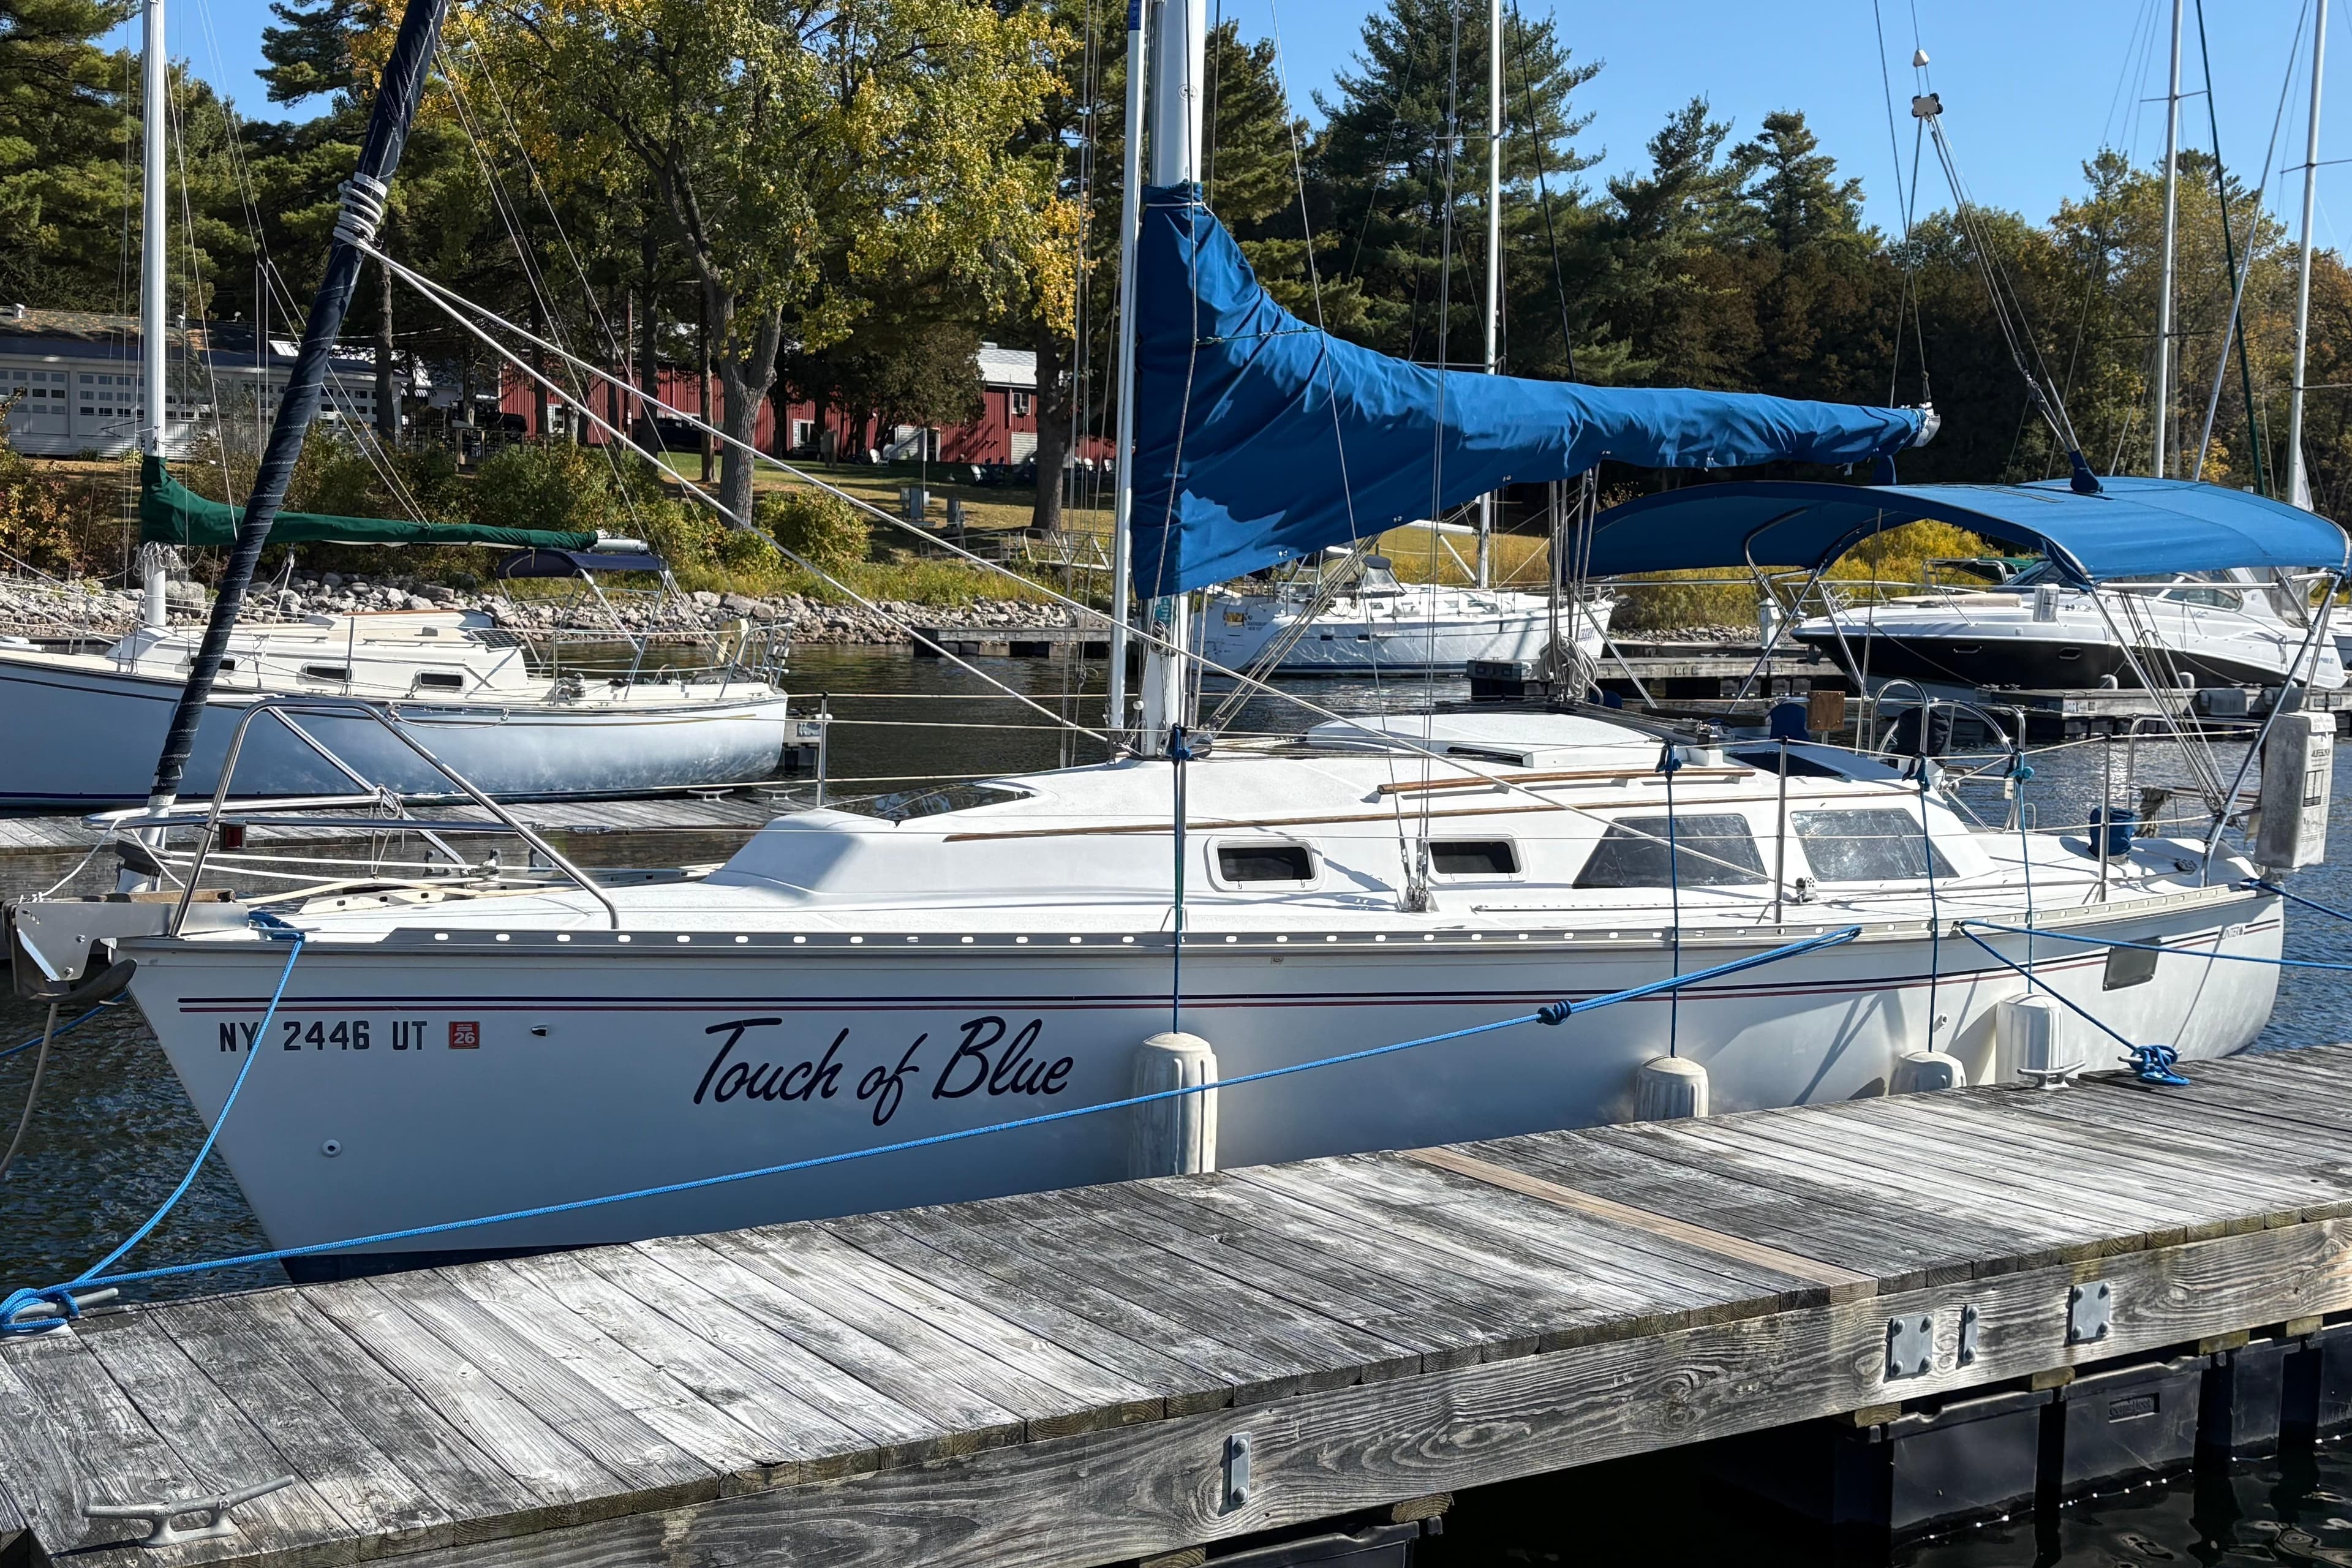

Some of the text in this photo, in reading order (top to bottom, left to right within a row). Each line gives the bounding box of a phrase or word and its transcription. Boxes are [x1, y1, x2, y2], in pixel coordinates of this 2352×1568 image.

[219, 1020, 428, 1052] NY 2446 UT
[453, 1031, 476, 1044] 26
[693, 1015, 1074, 1126] Touch of Blue
